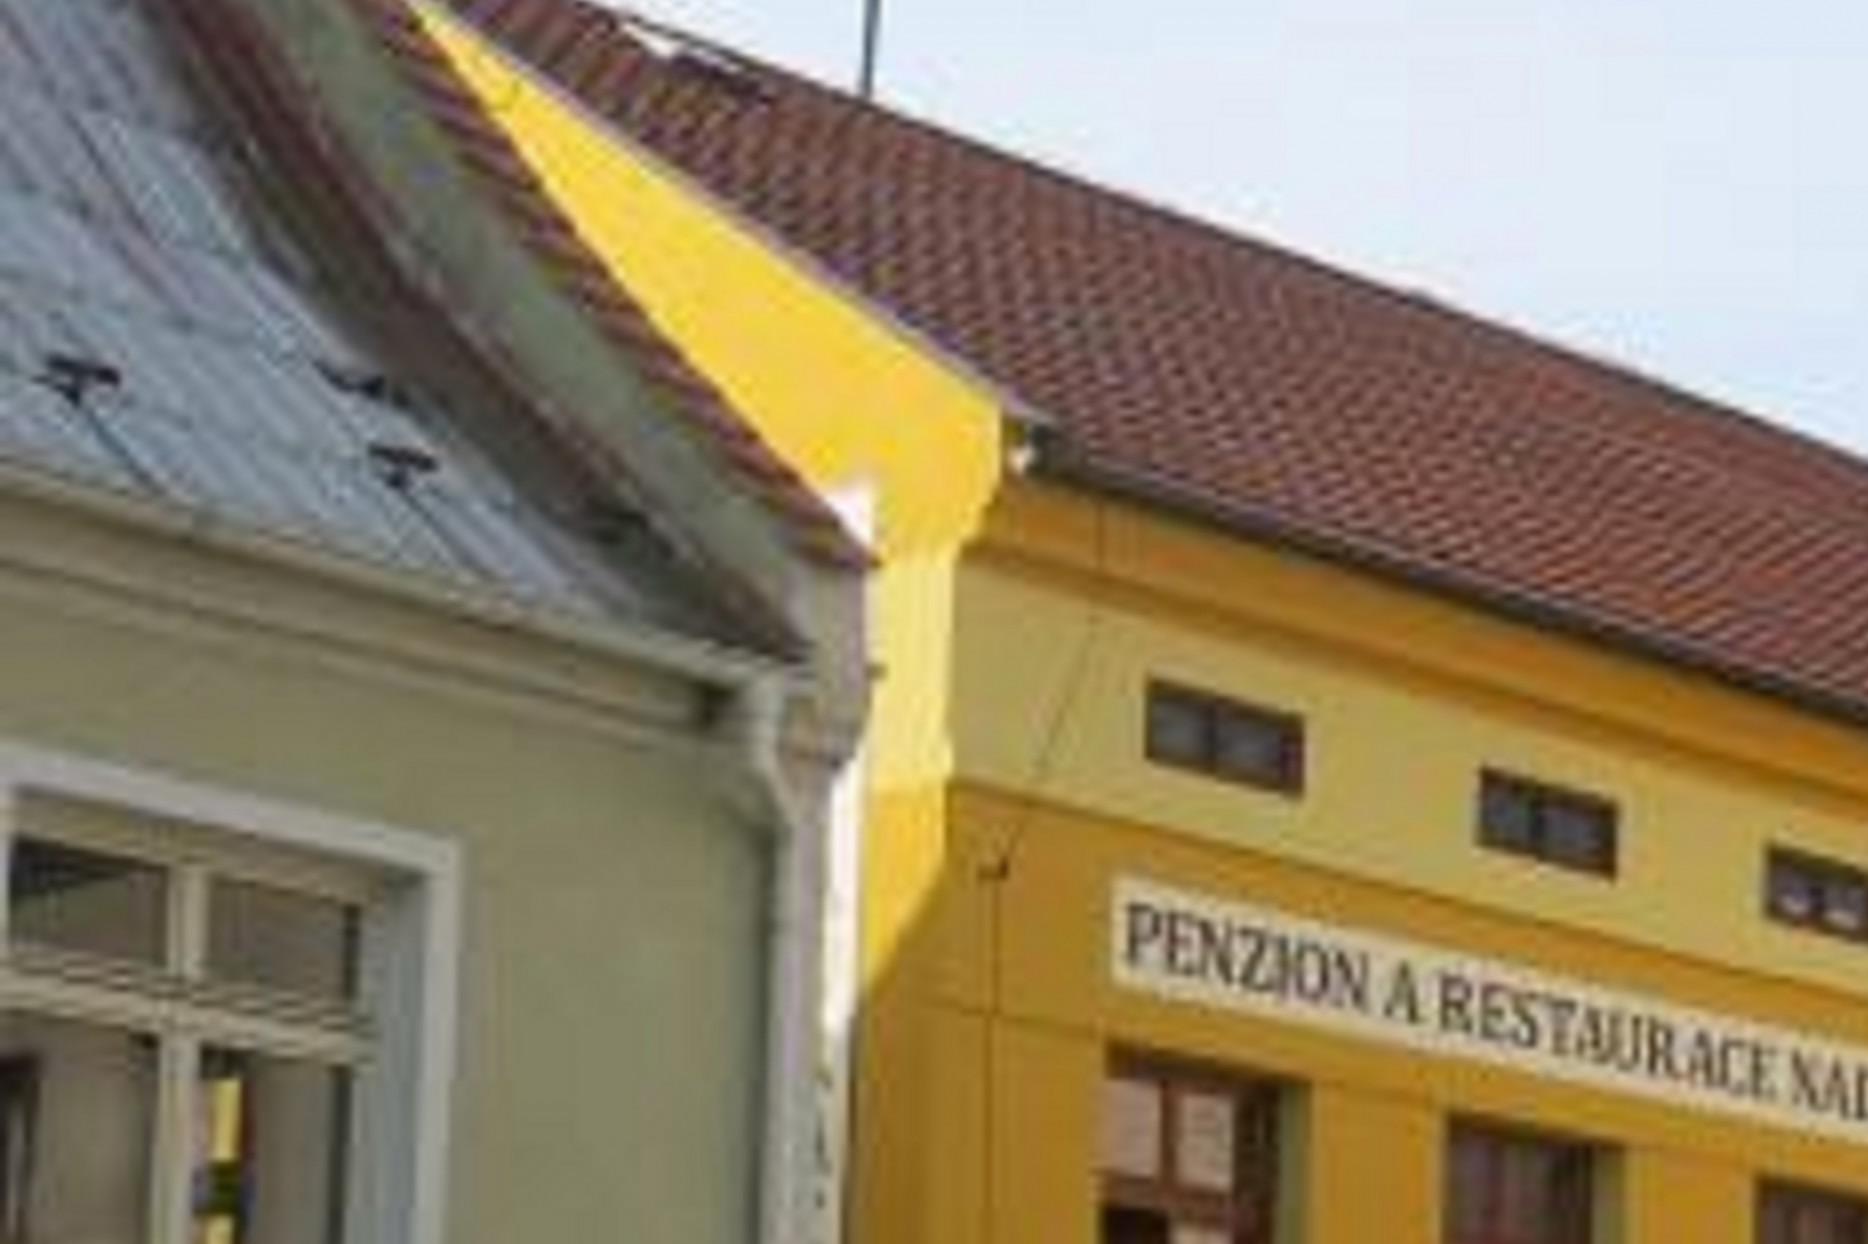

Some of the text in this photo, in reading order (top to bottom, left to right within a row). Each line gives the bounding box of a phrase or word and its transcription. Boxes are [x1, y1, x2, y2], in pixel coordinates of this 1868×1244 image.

[1125, 902, 1369, 1014] PENZION
[1382, 960, 1423, 1025] A
[1437, 970, 1778, 1097] RESTAURACE
